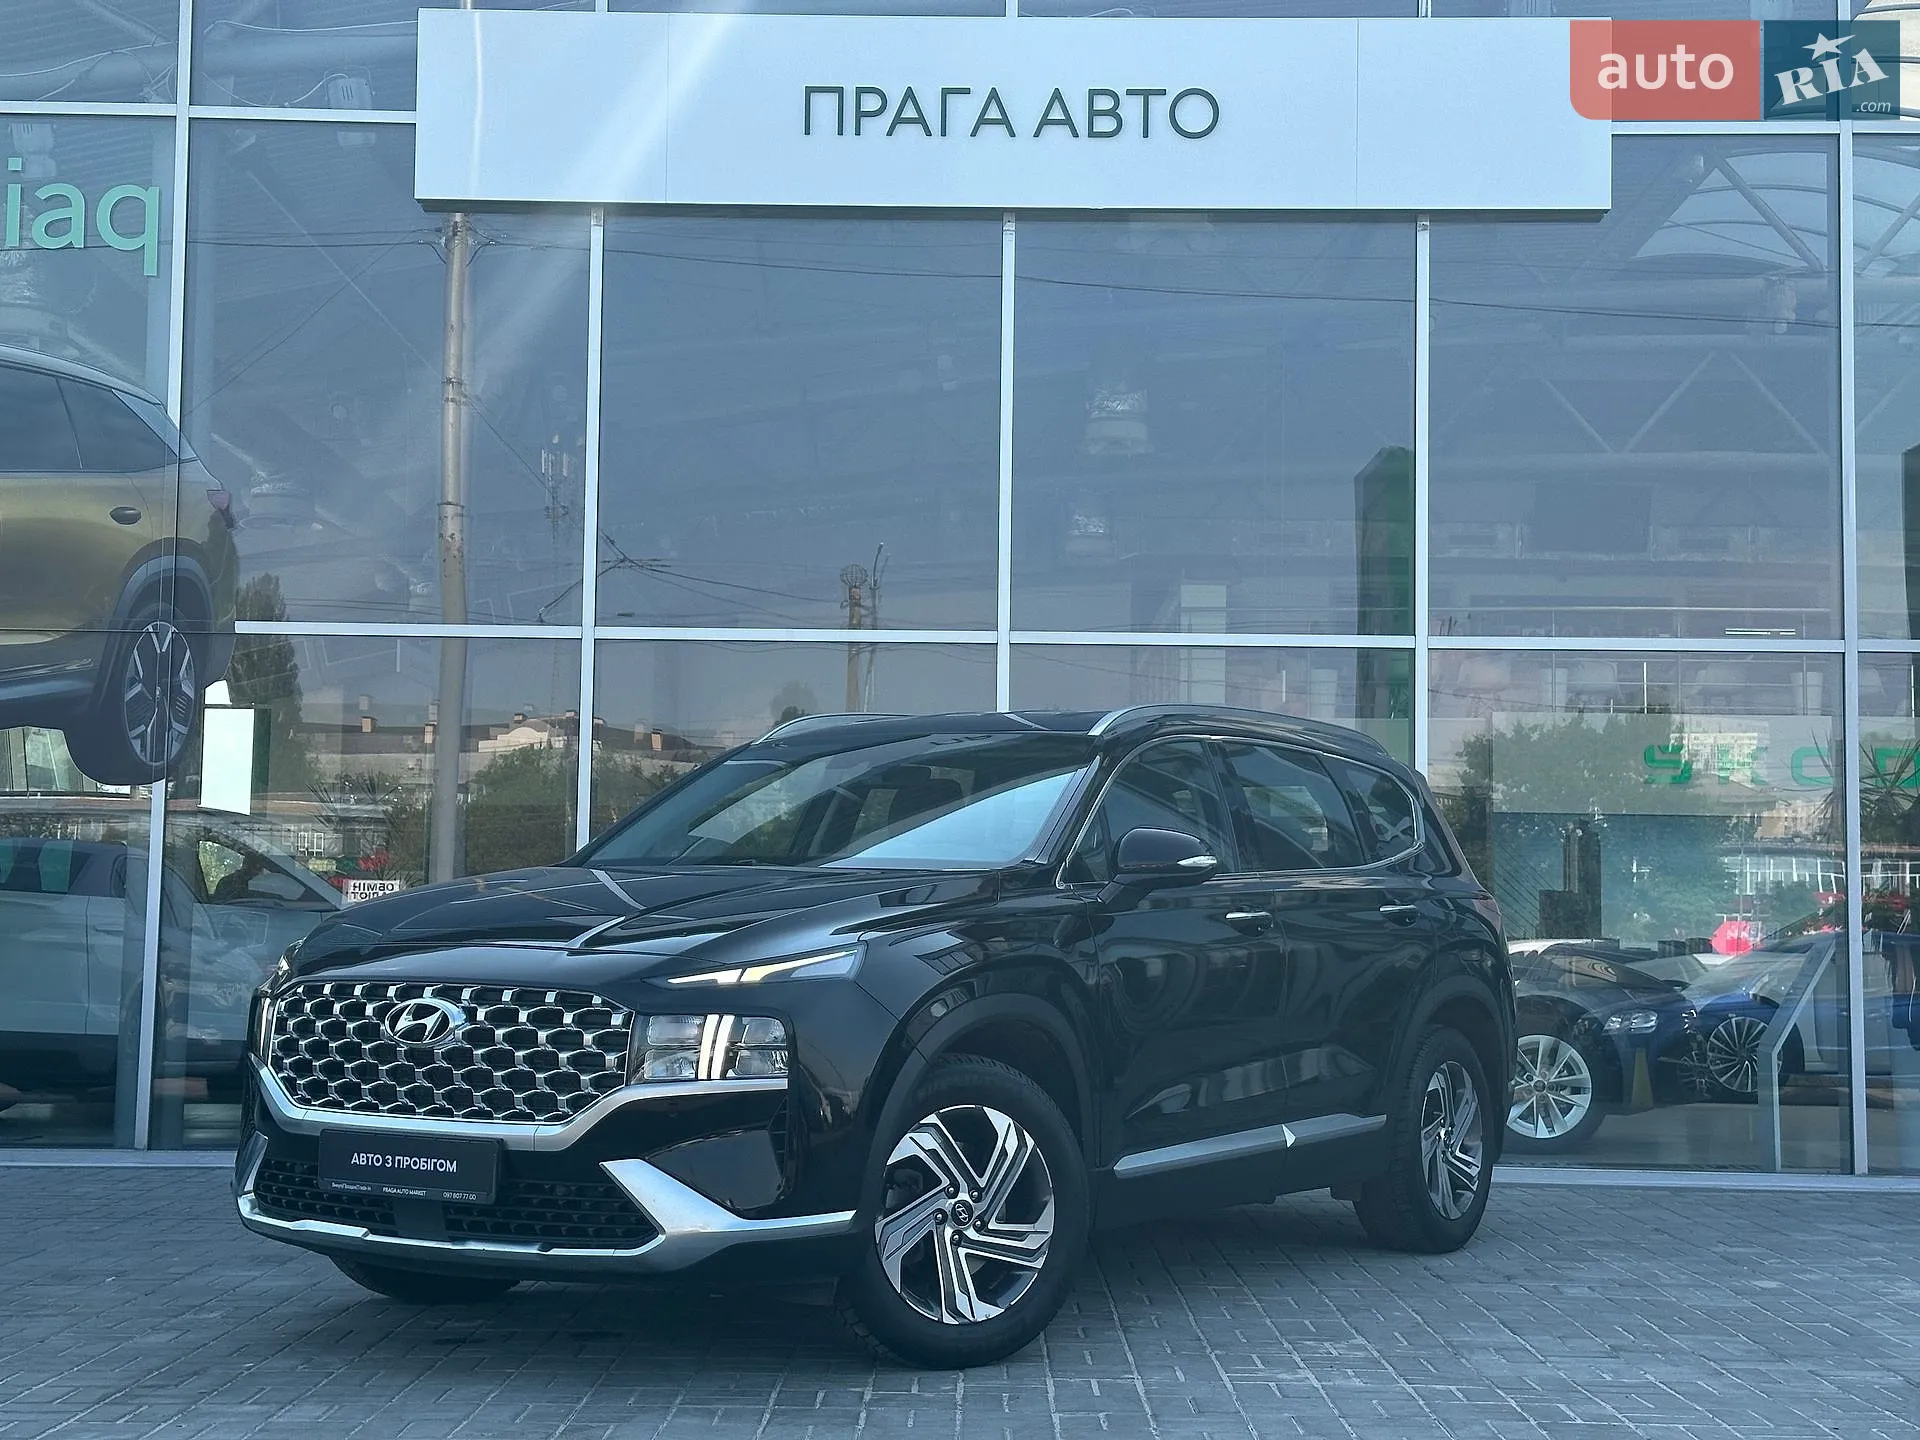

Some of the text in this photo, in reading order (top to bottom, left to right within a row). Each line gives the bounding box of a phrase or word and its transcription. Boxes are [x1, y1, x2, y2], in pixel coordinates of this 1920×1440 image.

[803, 85, 1220, 140] ПРАГА АВТО
[351, 1152, 383, 1168] АВТО
[394, 1156, 457, 1173] ПРОБІГОМ
